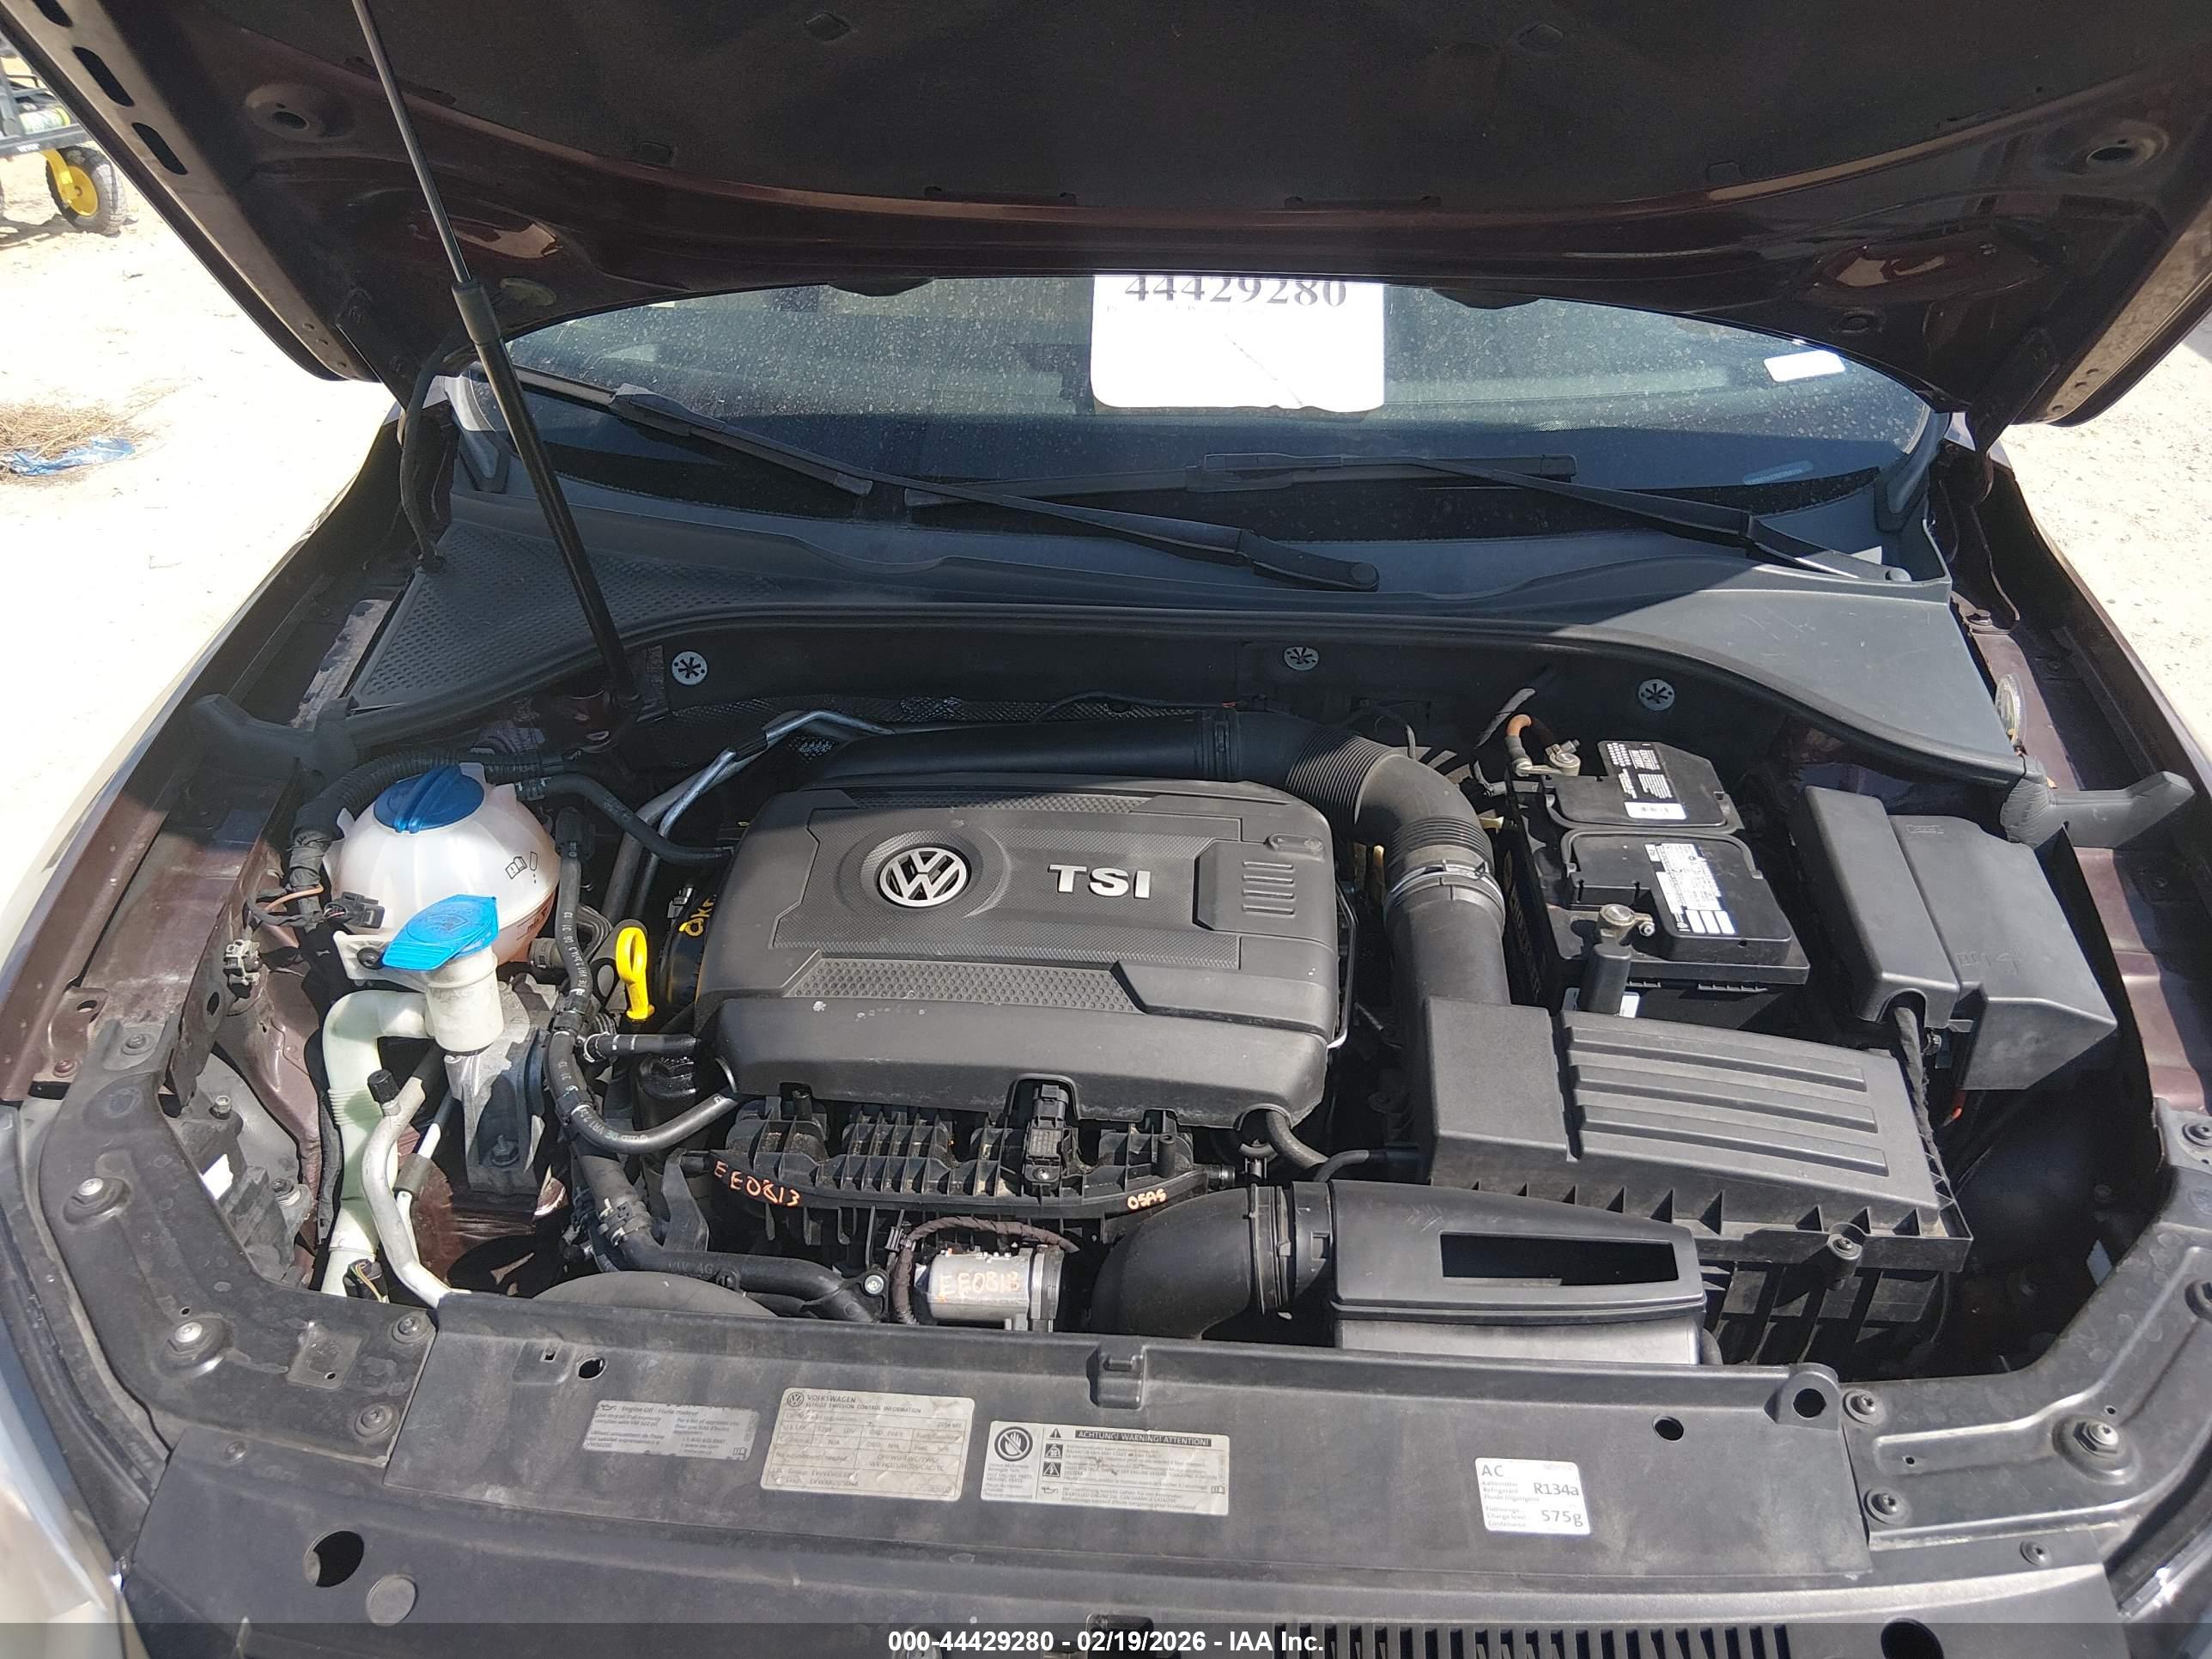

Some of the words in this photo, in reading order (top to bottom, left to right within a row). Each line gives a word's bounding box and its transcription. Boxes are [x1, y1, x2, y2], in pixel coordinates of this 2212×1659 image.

[1048, 863, 1152, 899] TSI
[806, 1394, 857, 1404] VOLKSWAGEN
[1121, 1432, 1163, 1444] WARNING!
[1163, 1435, 1209, 1447] ATTENTION!
[1481, 1464, 1504, 1477] AC
[1533, 1482, 1580, 1496] R134a
[1541, 1510, 1583, 1528] 575g
